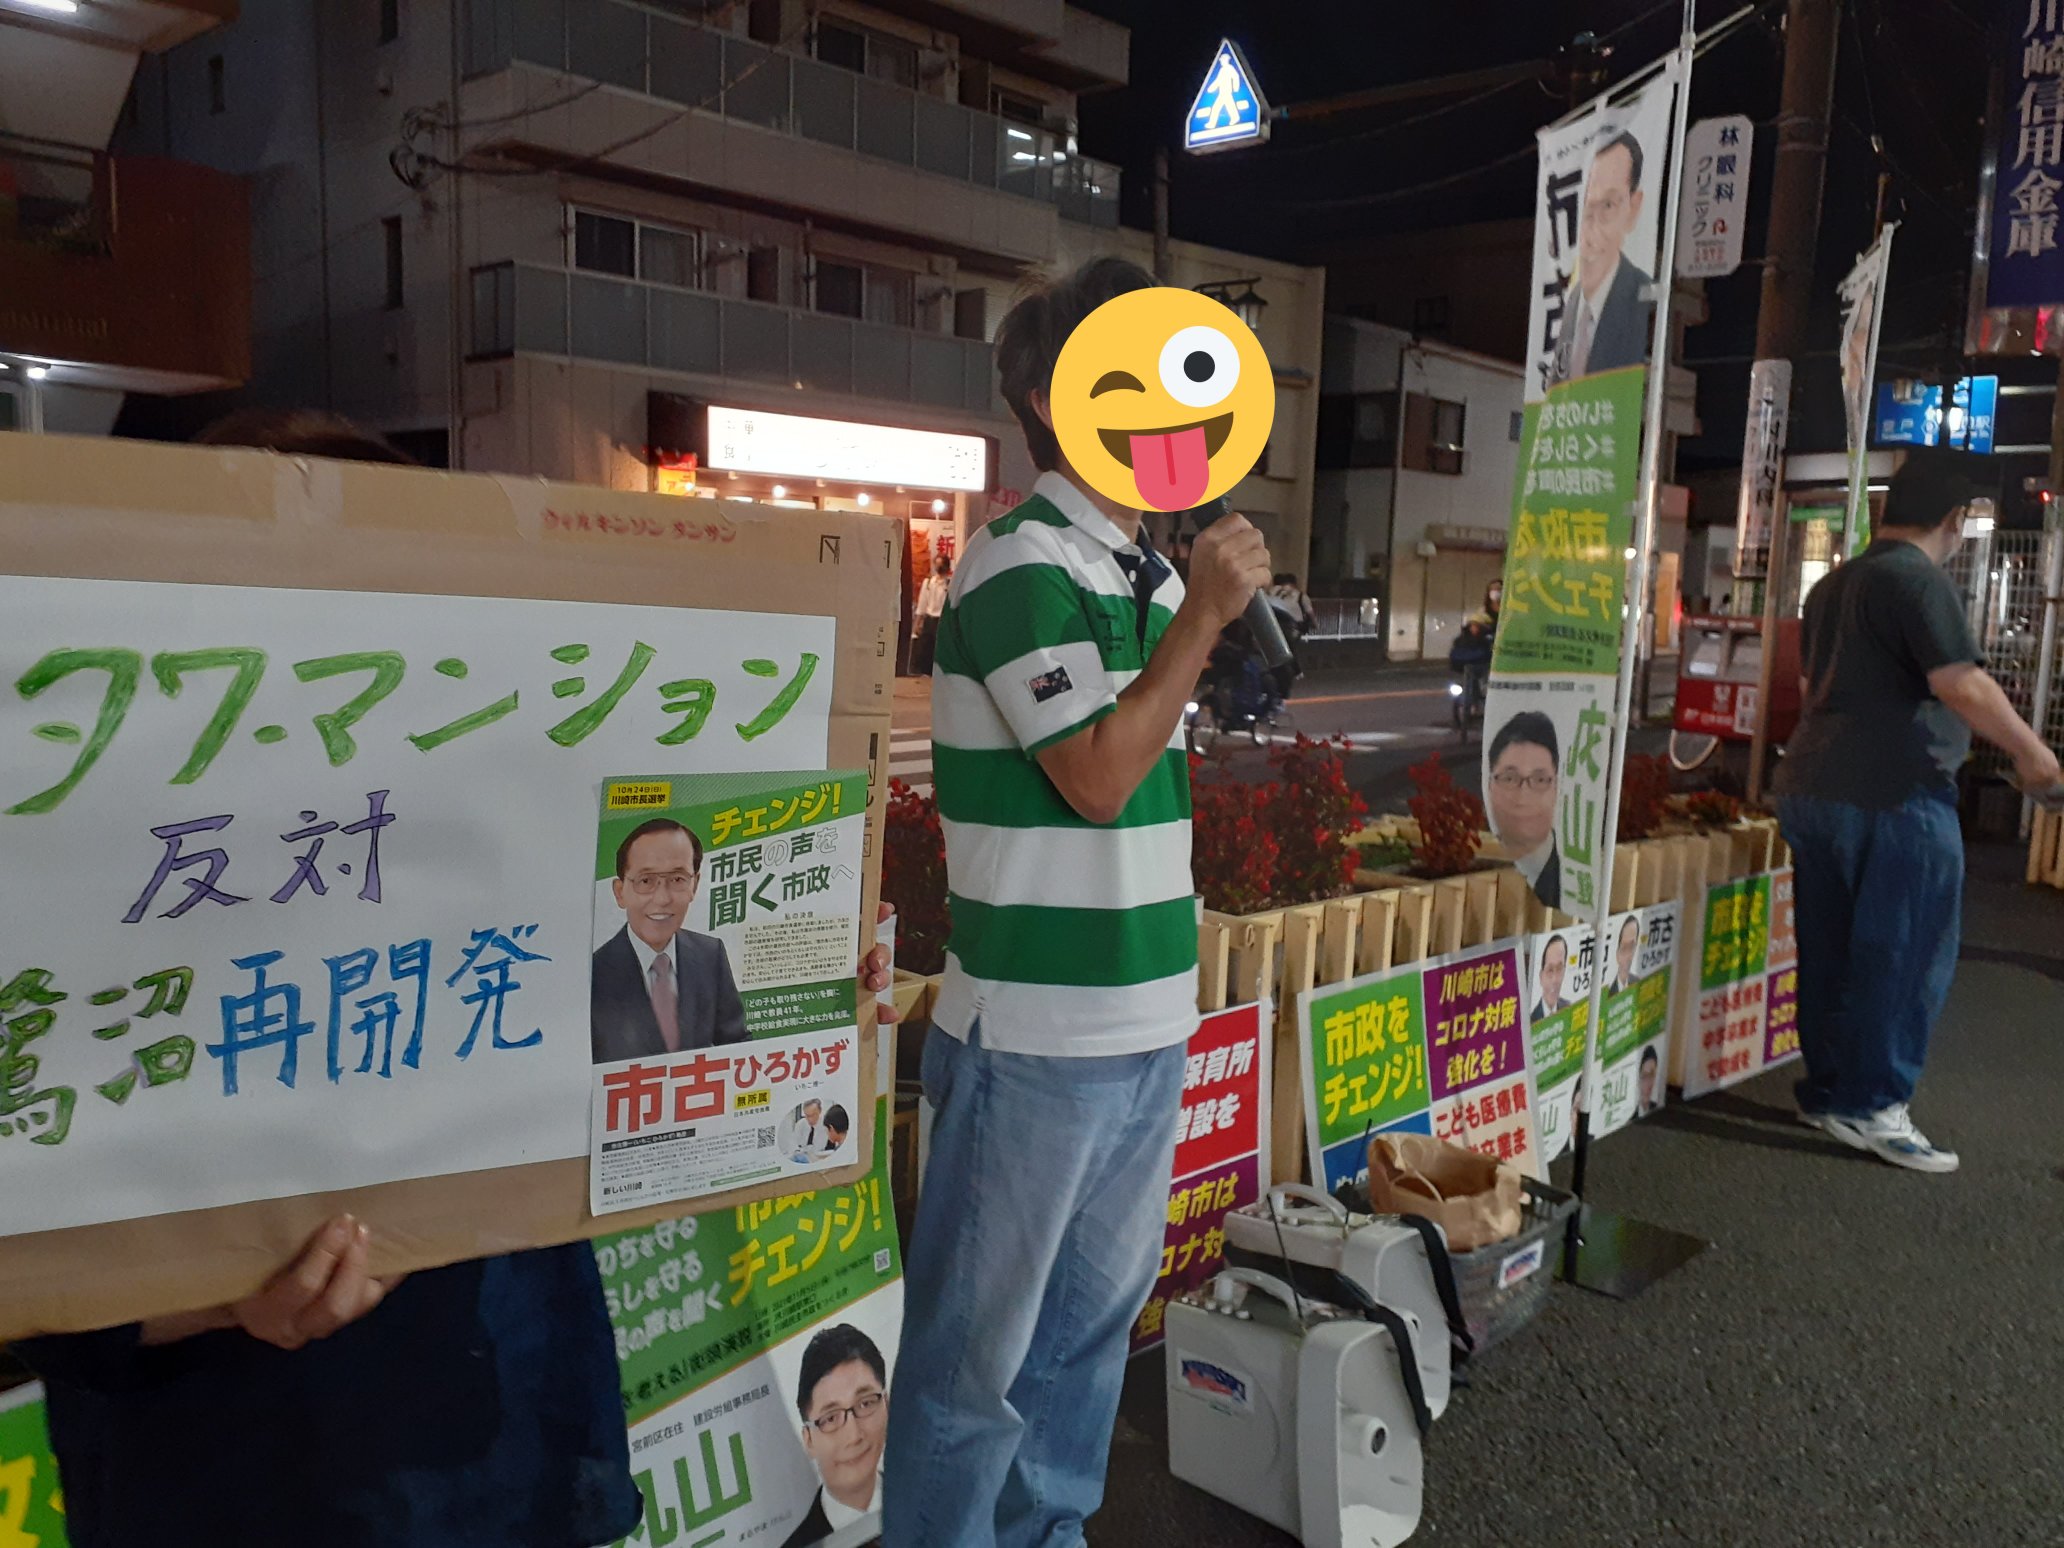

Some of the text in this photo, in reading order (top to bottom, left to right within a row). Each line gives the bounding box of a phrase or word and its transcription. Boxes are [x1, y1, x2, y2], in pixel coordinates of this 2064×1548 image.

[1716, 125, 1741, 204] 林眼科
[611, 793, 666, 806] 川崎市長選挙
[711, 782, 842, 845] チェンジ！
[121, 790, 396, 924] 反対
[709, 826, 839, 883] 市民の声を
[708, 864, 855, 932] 聞く市政へ
[1439, 962, 1506, 1005] 川崎市は
[1324, 995, 1410, 1067] 市政を
[1435, 996, 1518, 1047] コロナ対策
[737, 1092, 768, 1107] 無所属
[1324, 1044, 1424, 1127] チェンジ！
[1435, 1082, 1529, 1142] こども医療費
[603, 1181, 643, 1196] 新しい川崎
[727, 1177, 882, 1307] チェンジ！
[631, 1421, 685, 1454] 宮前区在住
